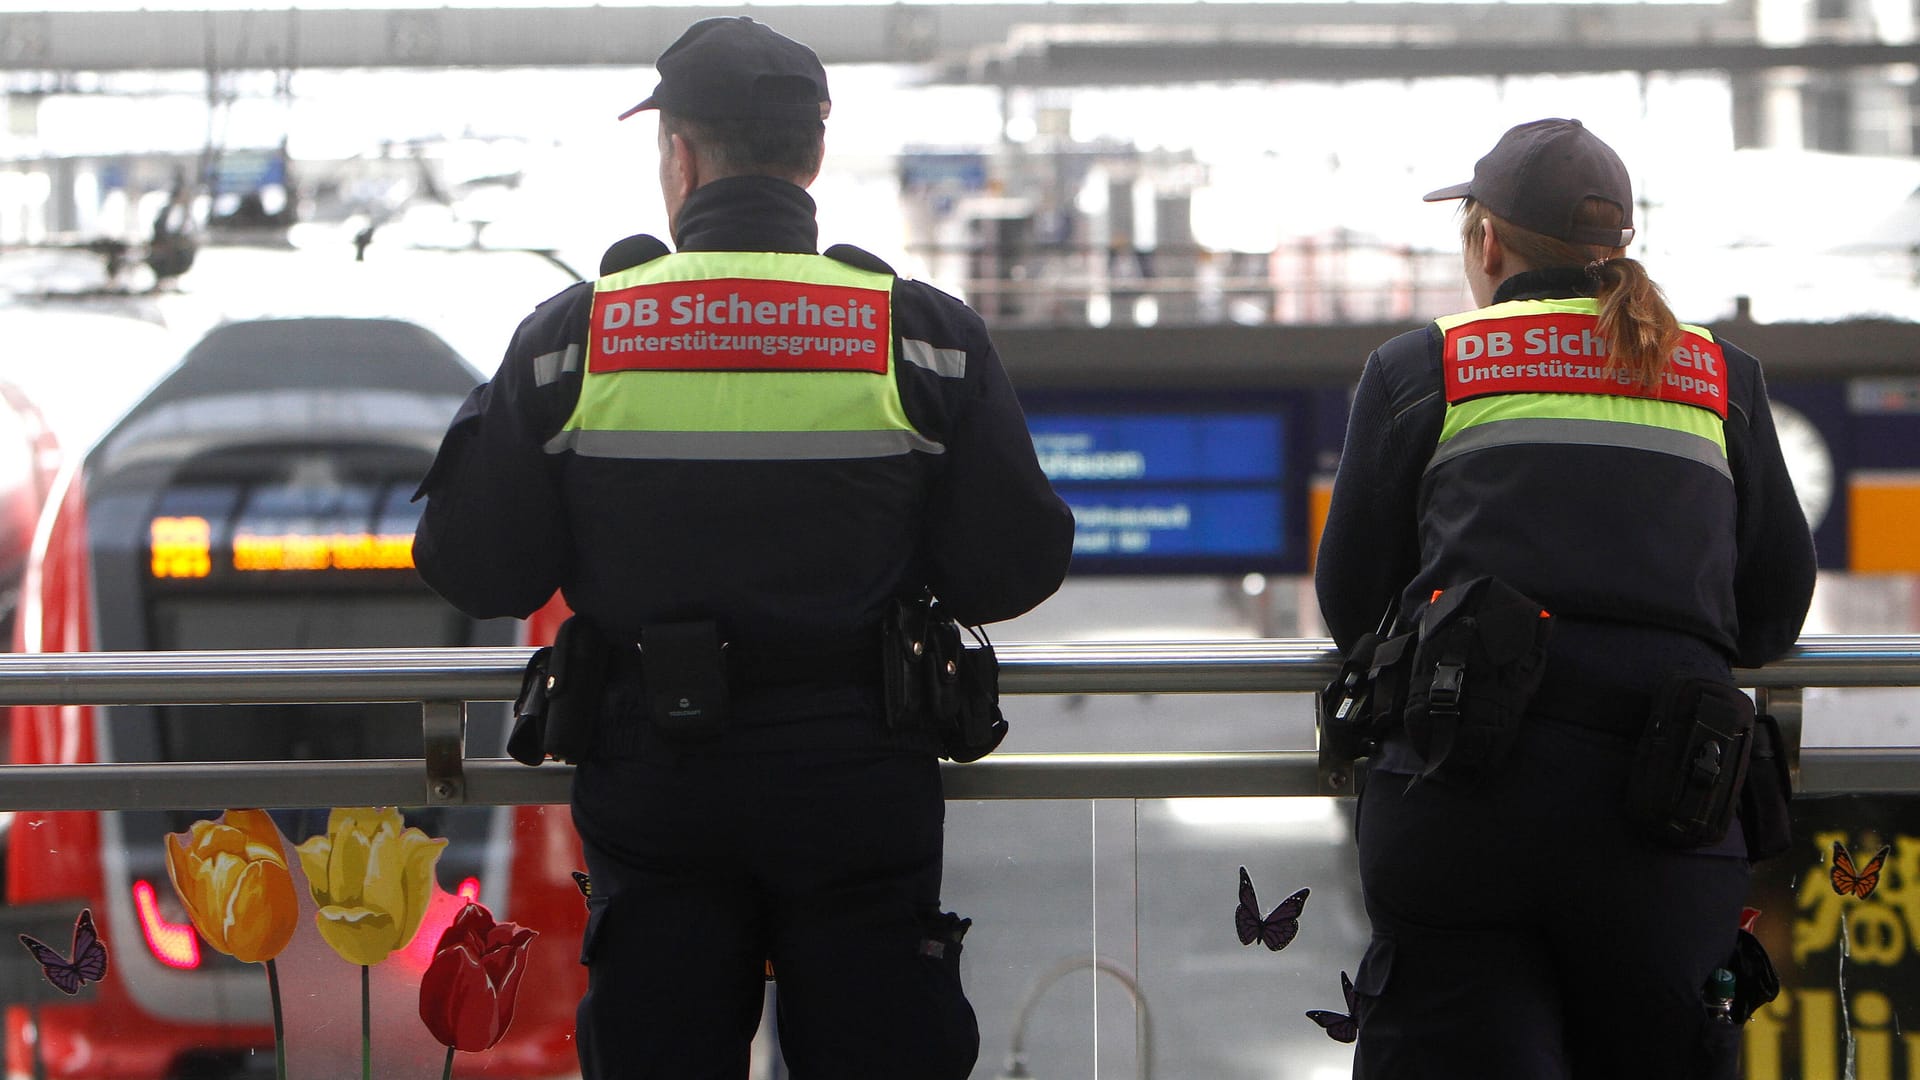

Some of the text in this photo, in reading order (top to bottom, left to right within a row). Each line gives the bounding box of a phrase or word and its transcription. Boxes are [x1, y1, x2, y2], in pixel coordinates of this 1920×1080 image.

[603, 293, 876, 329] DB Sicherheit
[602, 331, 876, 355] Unterstützungsgruppe
[1457, 327, 1718, 375] DB Sicheit
[1458, 361, 1720, 397] Unterstützungsuppe
